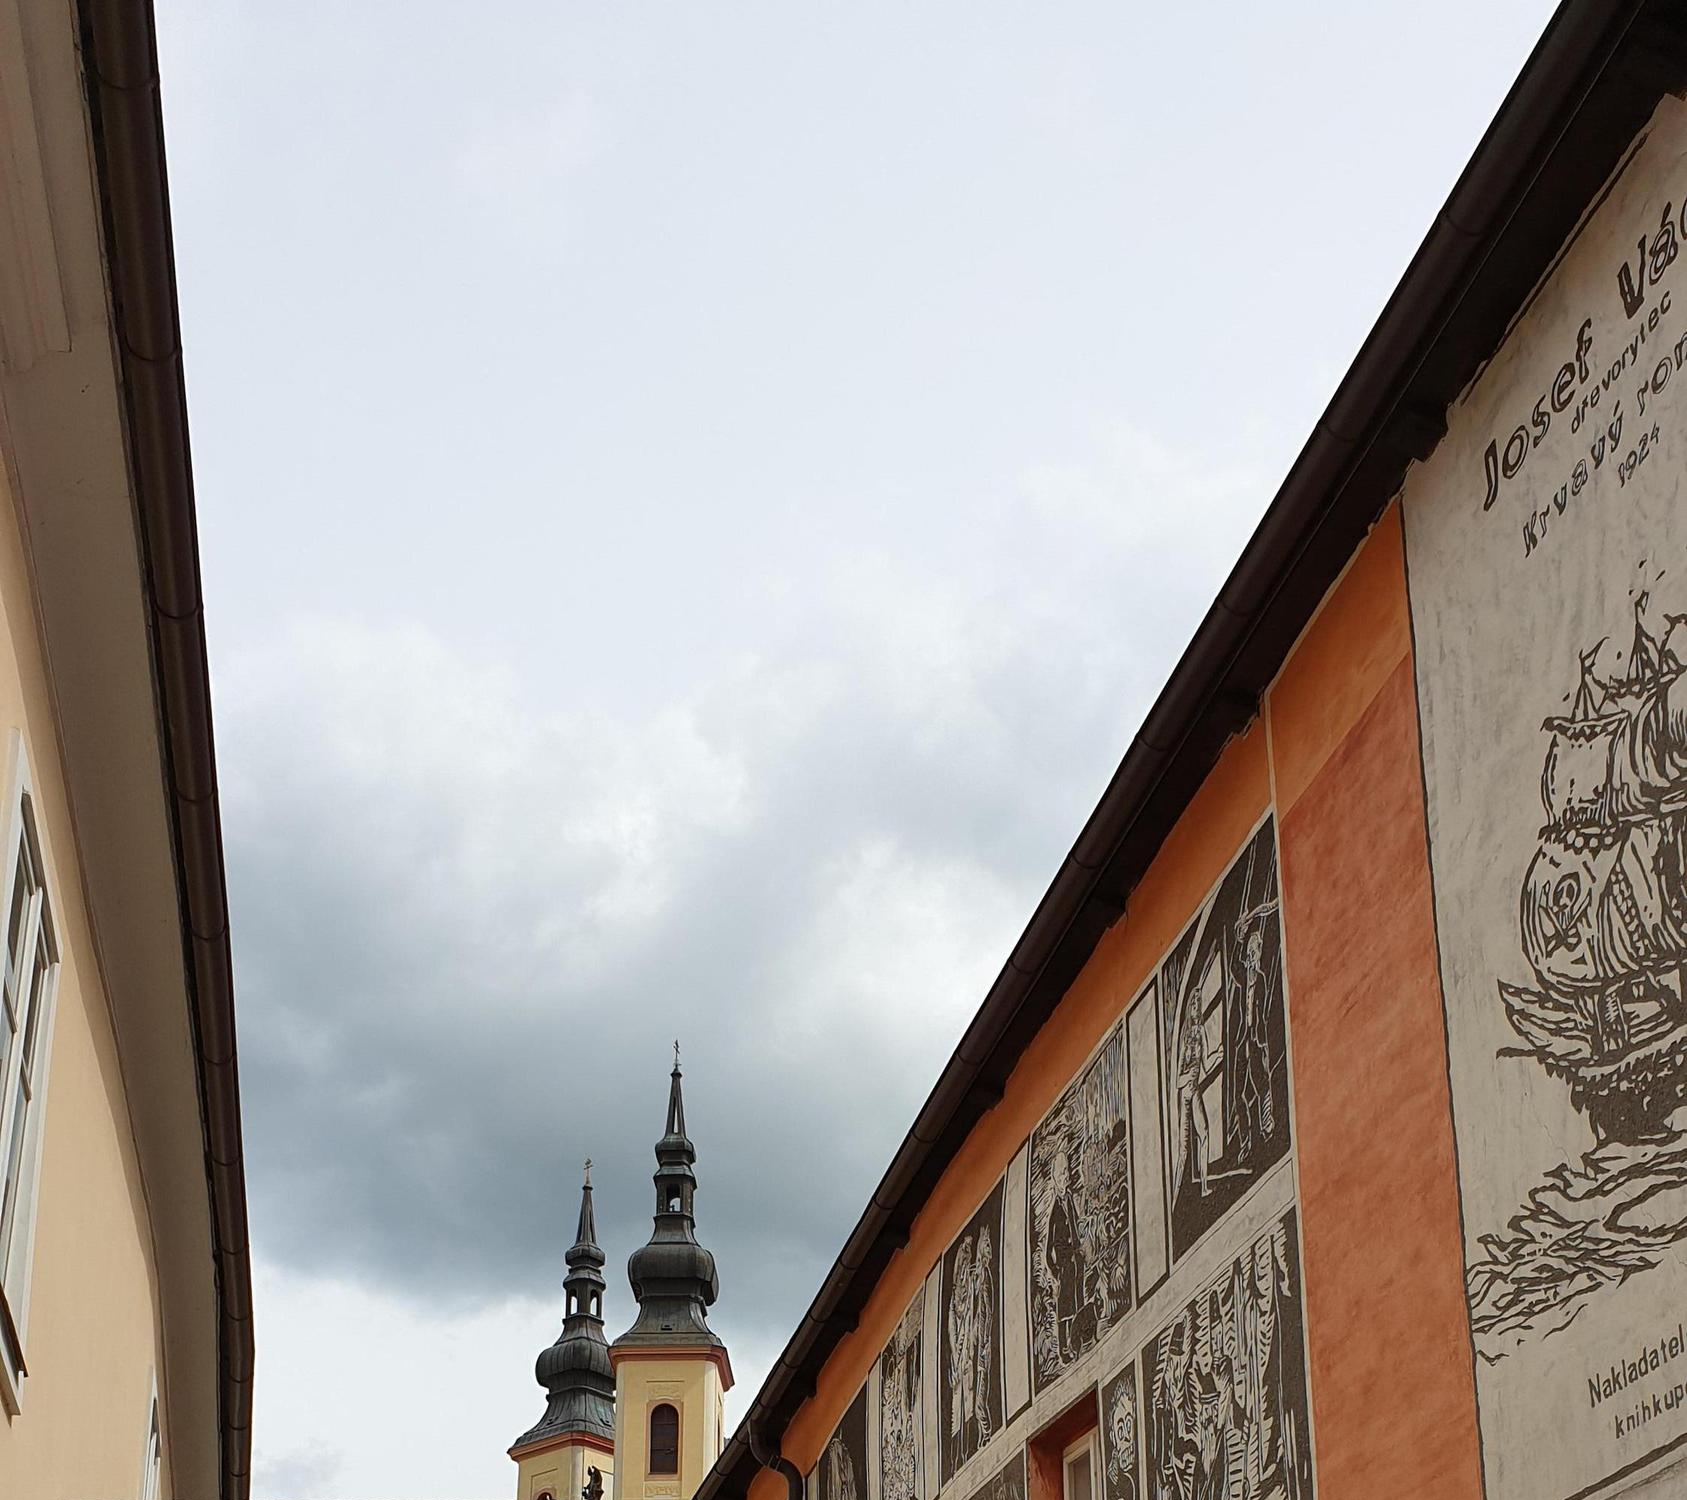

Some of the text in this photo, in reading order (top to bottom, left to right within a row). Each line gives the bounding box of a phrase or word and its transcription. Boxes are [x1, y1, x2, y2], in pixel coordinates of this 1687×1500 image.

[1483, 197, 1687, 511] Josef Vá
[1523, 400, 1624, 557] Krvavý
[1617, 421, 1660, 488] 1924
[1587, 1323, 1687, 1408] Nakladatel
[1614, 1382, 1687, 1439] knihkup
